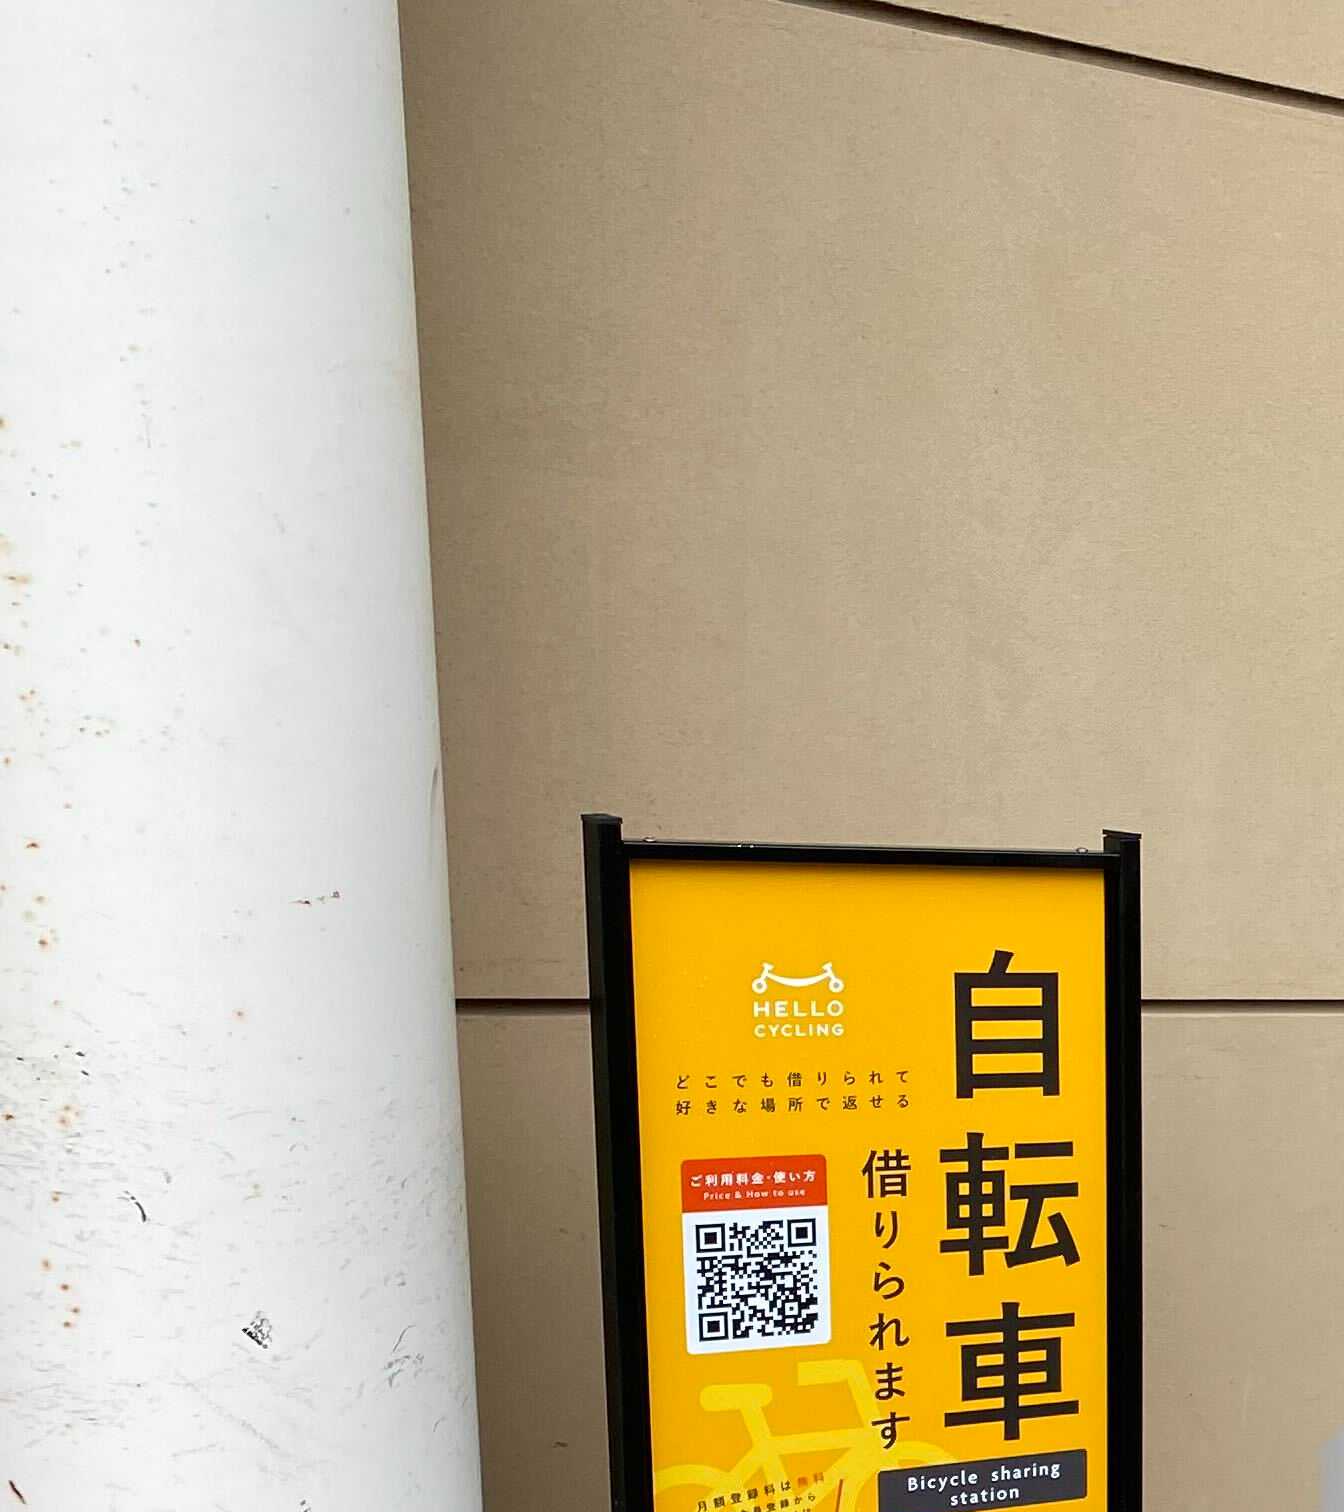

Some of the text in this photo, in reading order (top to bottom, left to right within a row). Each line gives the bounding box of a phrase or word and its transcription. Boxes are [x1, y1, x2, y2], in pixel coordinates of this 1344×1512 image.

[753, 999, 844, 1017] HELLO
[754, 1023, 845, 1038] CYCLING
[675, 1070, 910, 1090] どこでも借りられて
[675, 1094, 910, 1115] 好きな場所で返せる
[703, 1191, 731, 1200] Price
[746, 1190, 769, 1198] How
[773, 1188, 784, 1197] to
[940, 949, 1082, 1441] 自転車
[861, 1149, 912, 1449] 借りられます
[907, 1463, 1061, 1492] Bicycle sharing
[950, 1487, 1020, 1507] station
